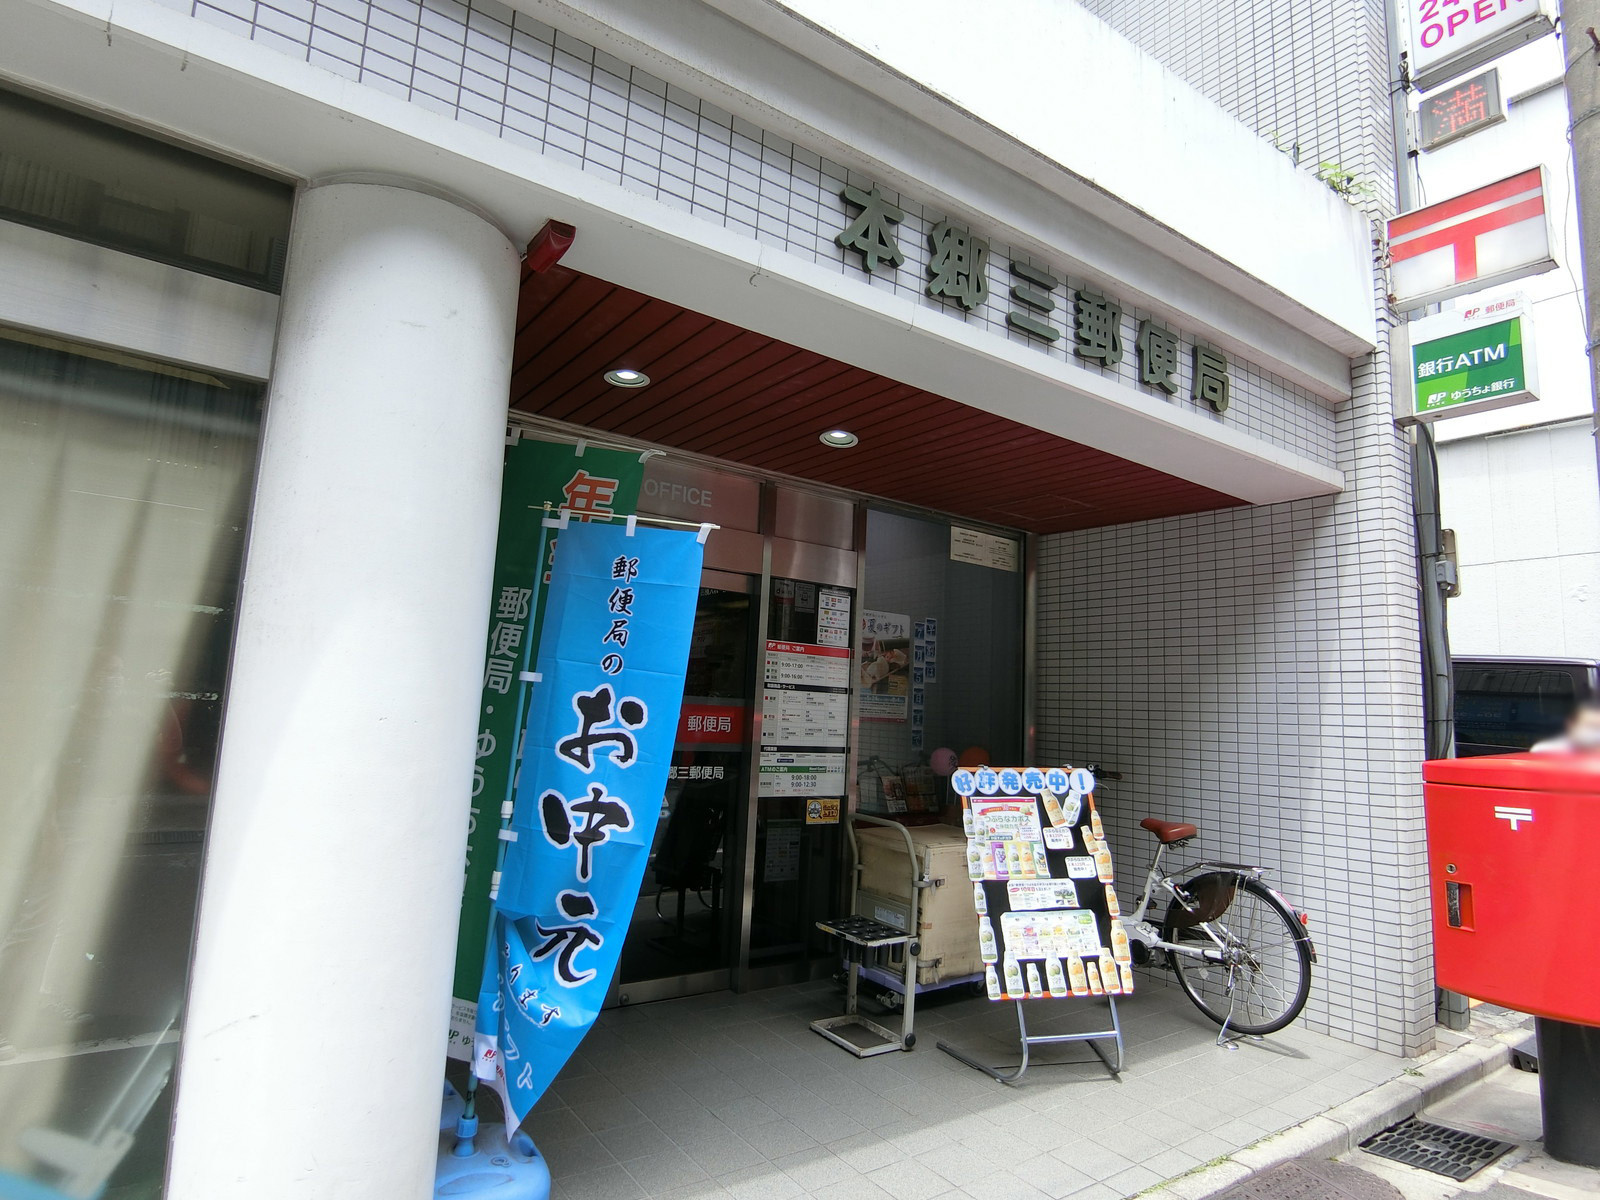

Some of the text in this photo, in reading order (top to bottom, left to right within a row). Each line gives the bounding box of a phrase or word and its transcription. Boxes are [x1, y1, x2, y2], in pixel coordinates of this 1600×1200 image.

[1432, 83, 1488, 141] 満
[834, 187, 1230, 413] 本郷三郵便局
[1485, 299, 1516, 314] 郵便局
[1418, 343, 1505, 378] 銀行ATM
[1451, 378, 1515, 400] ゆうちょ銀行
[644, 478, 713, 508] OFFICE
[601, 554, 640, 676] 郵便局の
[687, 715, 732, 733] 郵便局
[984, 815, 1031, 823] つぶらなカボス
[531, 682, 649, 989] お中元
